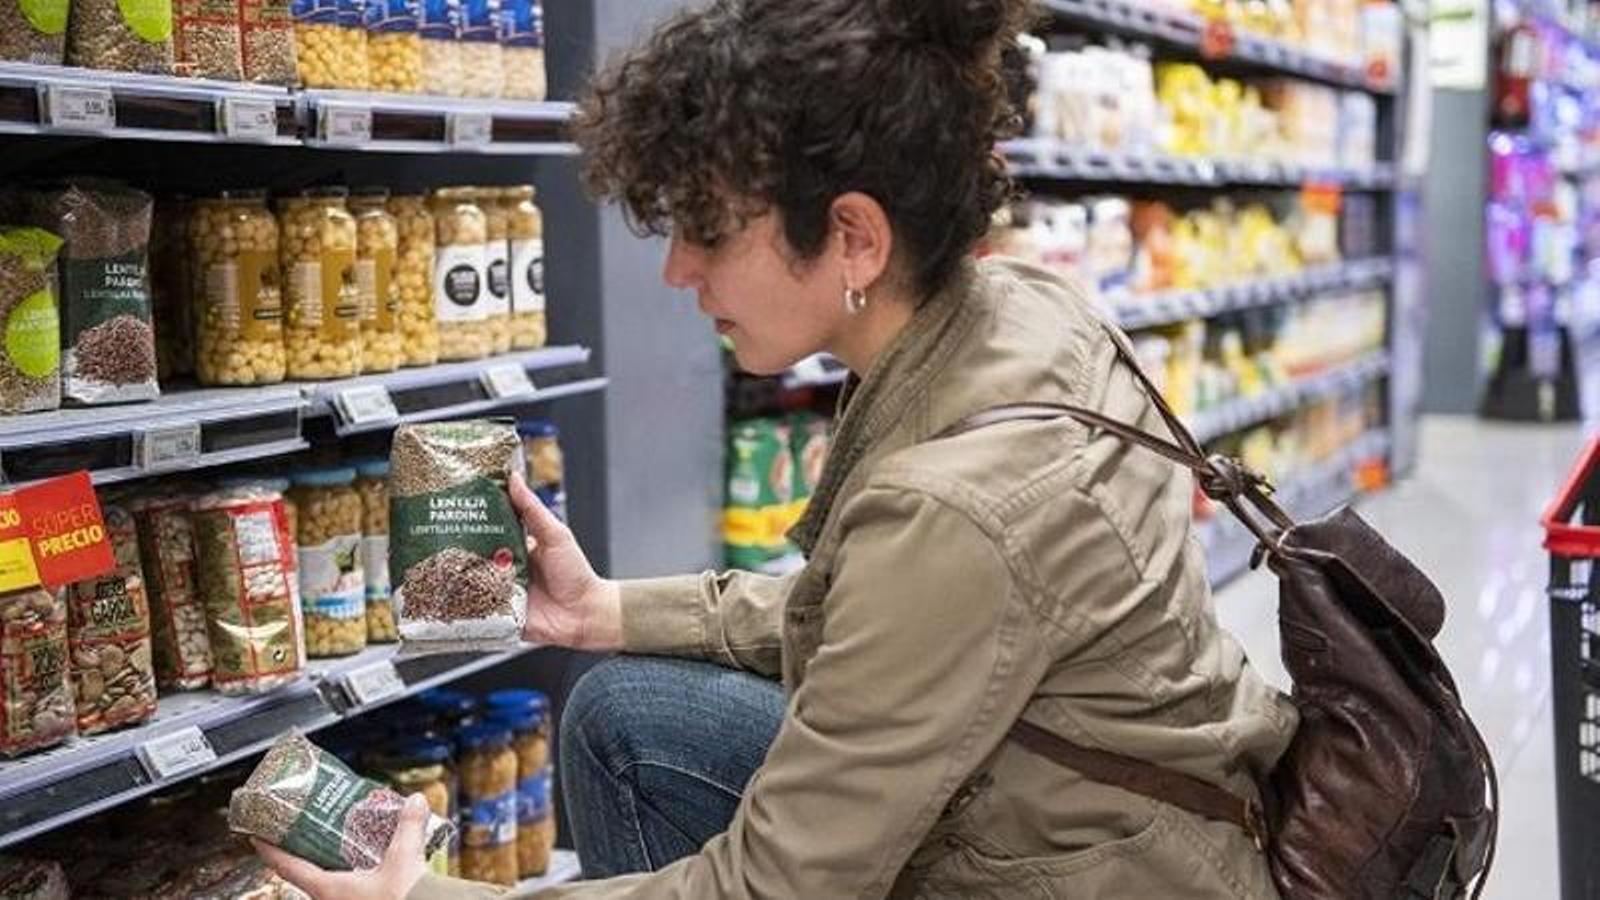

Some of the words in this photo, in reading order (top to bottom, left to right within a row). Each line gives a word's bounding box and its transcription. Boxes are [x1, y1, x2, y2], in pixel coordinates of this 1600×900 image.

[429, 498, 488, 509] LENTEJA
[32, 503, 98, 538] SUPER
[430, 510, 489, 521] PARDINA
[38, 524, 104, 558] PRECIO
